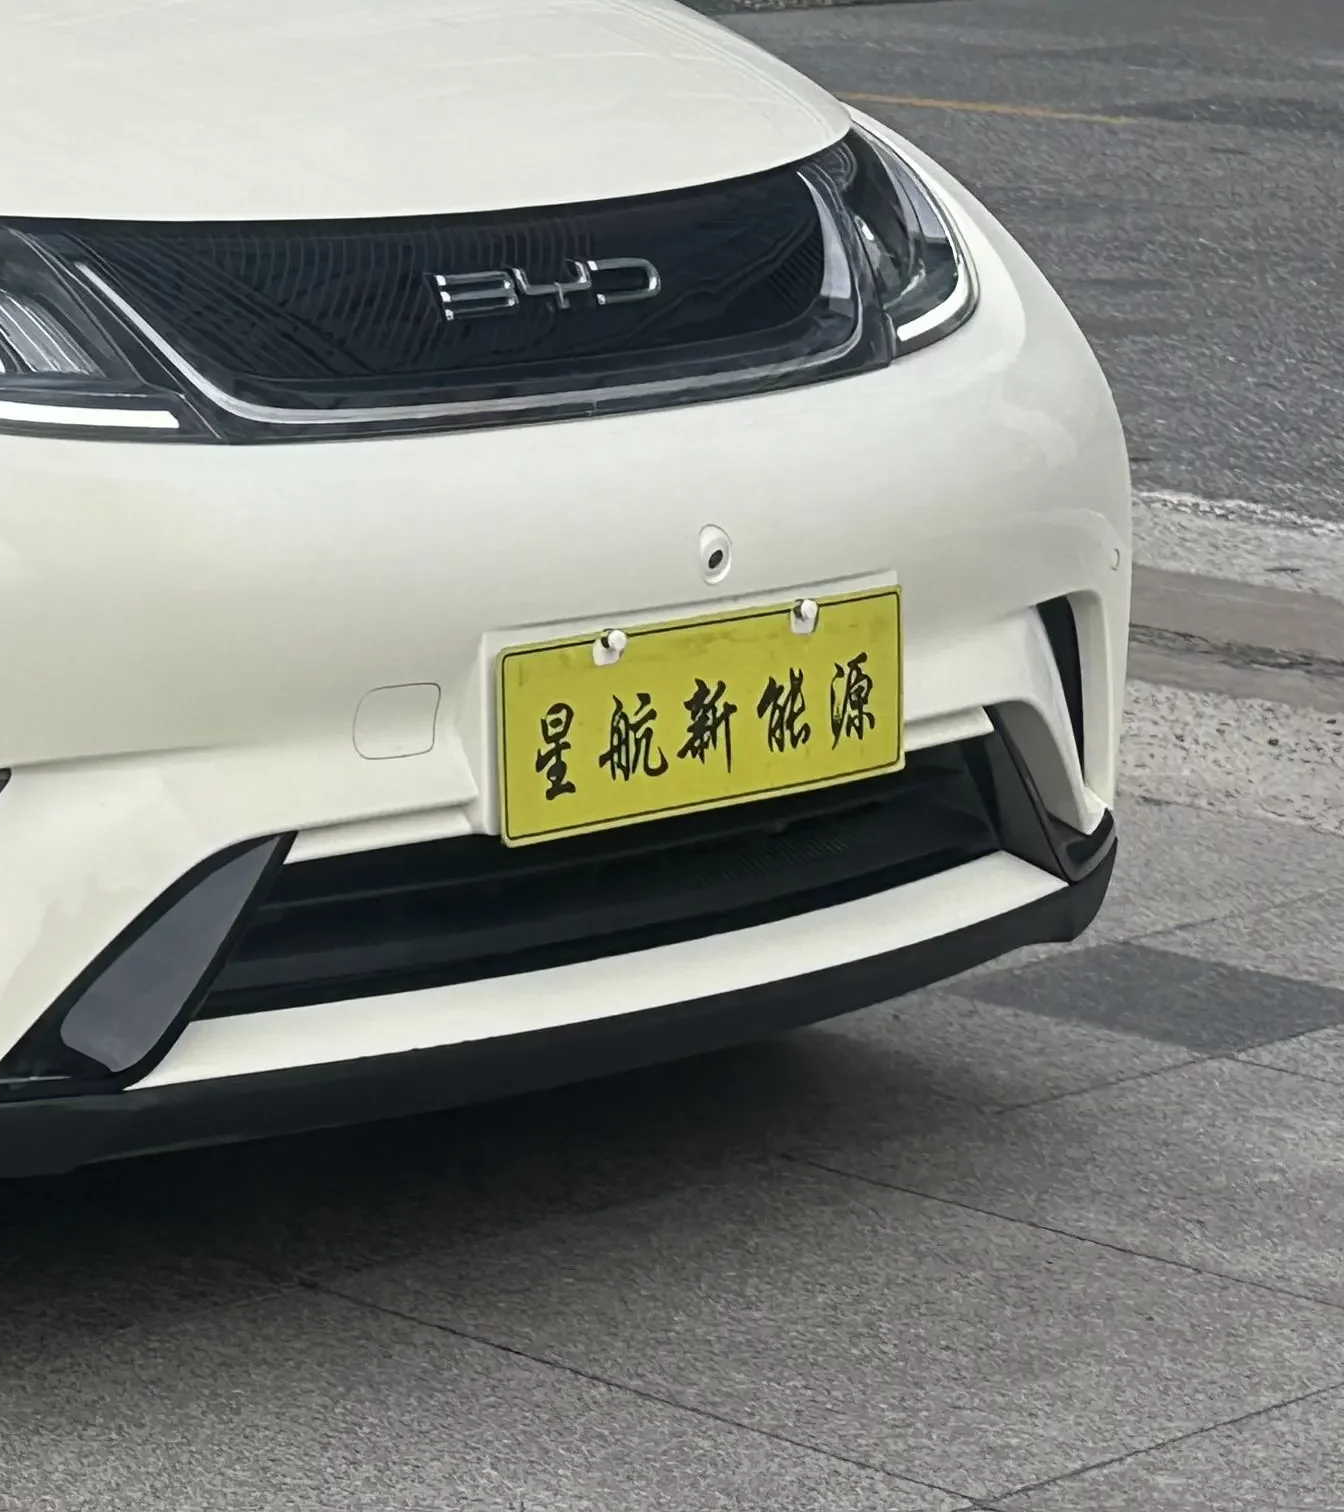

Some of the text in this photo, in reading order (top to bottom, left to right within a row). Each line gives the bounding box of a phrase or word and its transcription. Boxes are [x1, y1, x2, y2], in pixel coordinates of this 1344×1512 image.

[427, 256, 662, 322] BYD
[534, 651, 877, 801] 星航新能源
